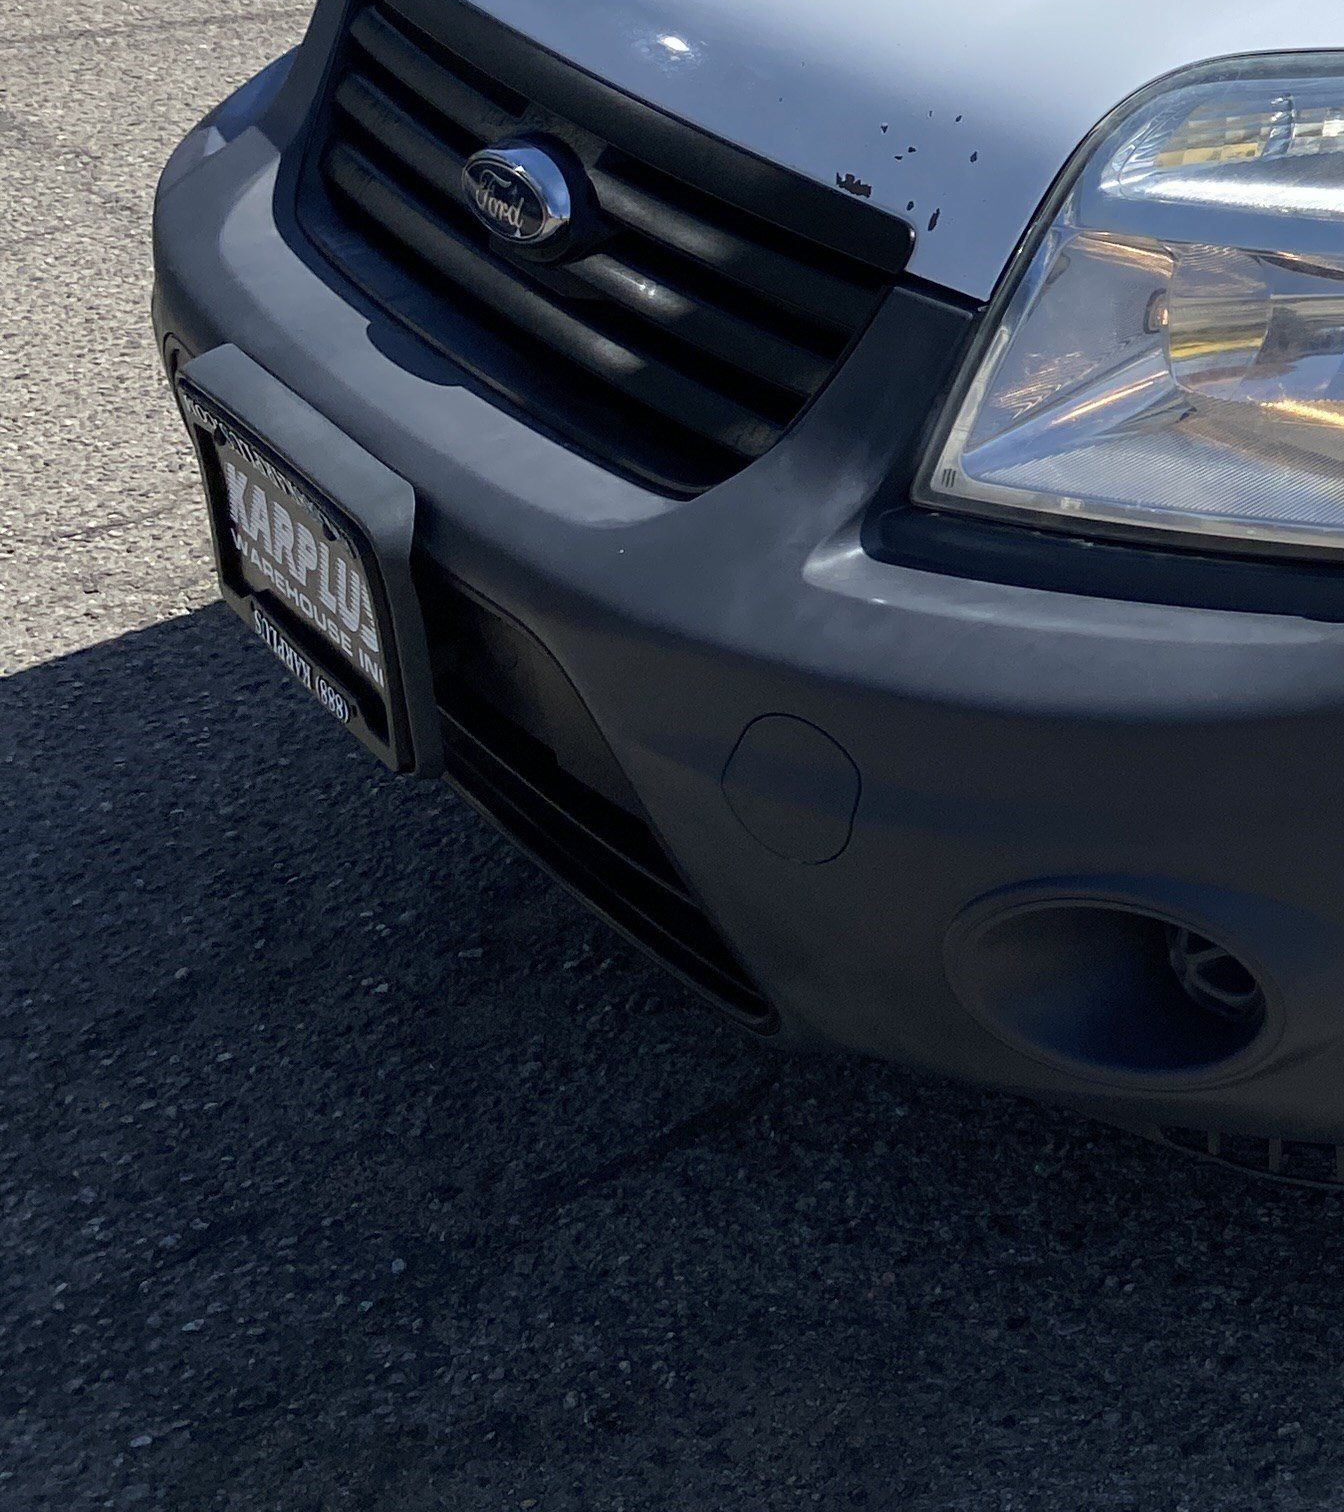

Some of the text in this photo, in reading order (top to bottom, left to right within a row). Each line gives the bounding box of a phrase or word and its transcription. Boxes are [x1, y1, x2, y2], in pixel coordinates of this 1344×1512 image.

[475, 169, 524, 228] Ford
[230, 527, 353, 657] WAREHOUSE
[254, 609, 313, 690] KARPLUS
